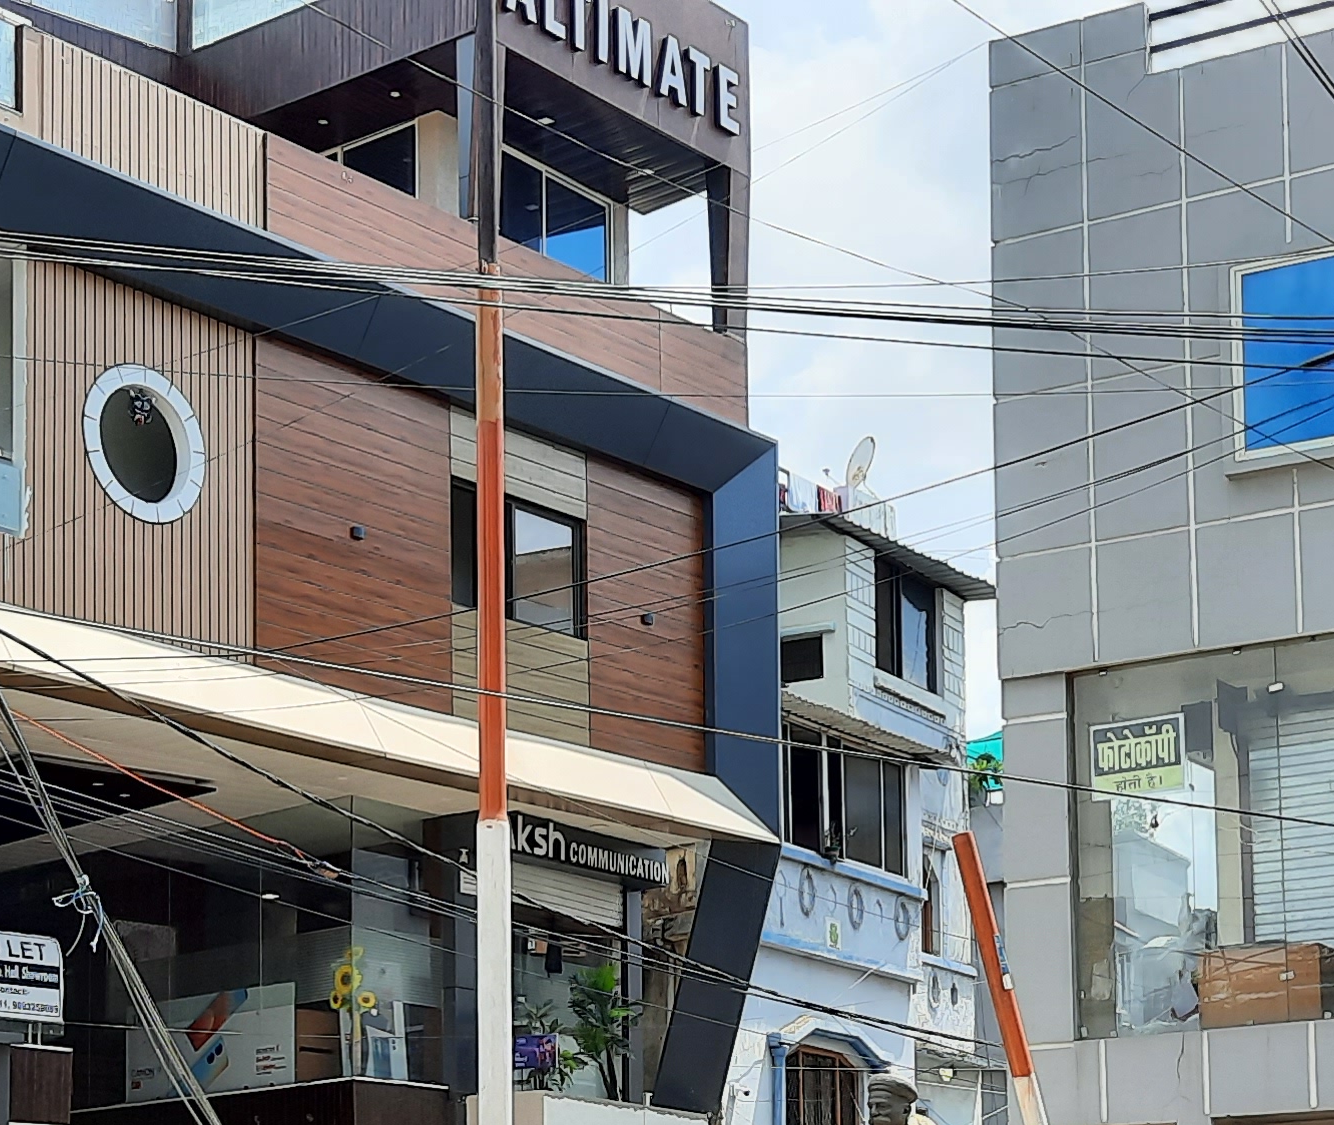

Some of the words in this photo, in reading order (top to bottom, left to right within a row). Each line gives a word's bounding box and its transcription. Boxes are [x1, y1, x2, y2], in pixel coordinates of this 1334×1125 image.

[1097, 723, 1177, 771] फोटोकॉपी
[1113, 774, 1141, 793] होती
[511, 814, 566, 861] ksh
[569, 841, 670, 885] COMMUNICATION
[7, 940, 46, 961] LET
